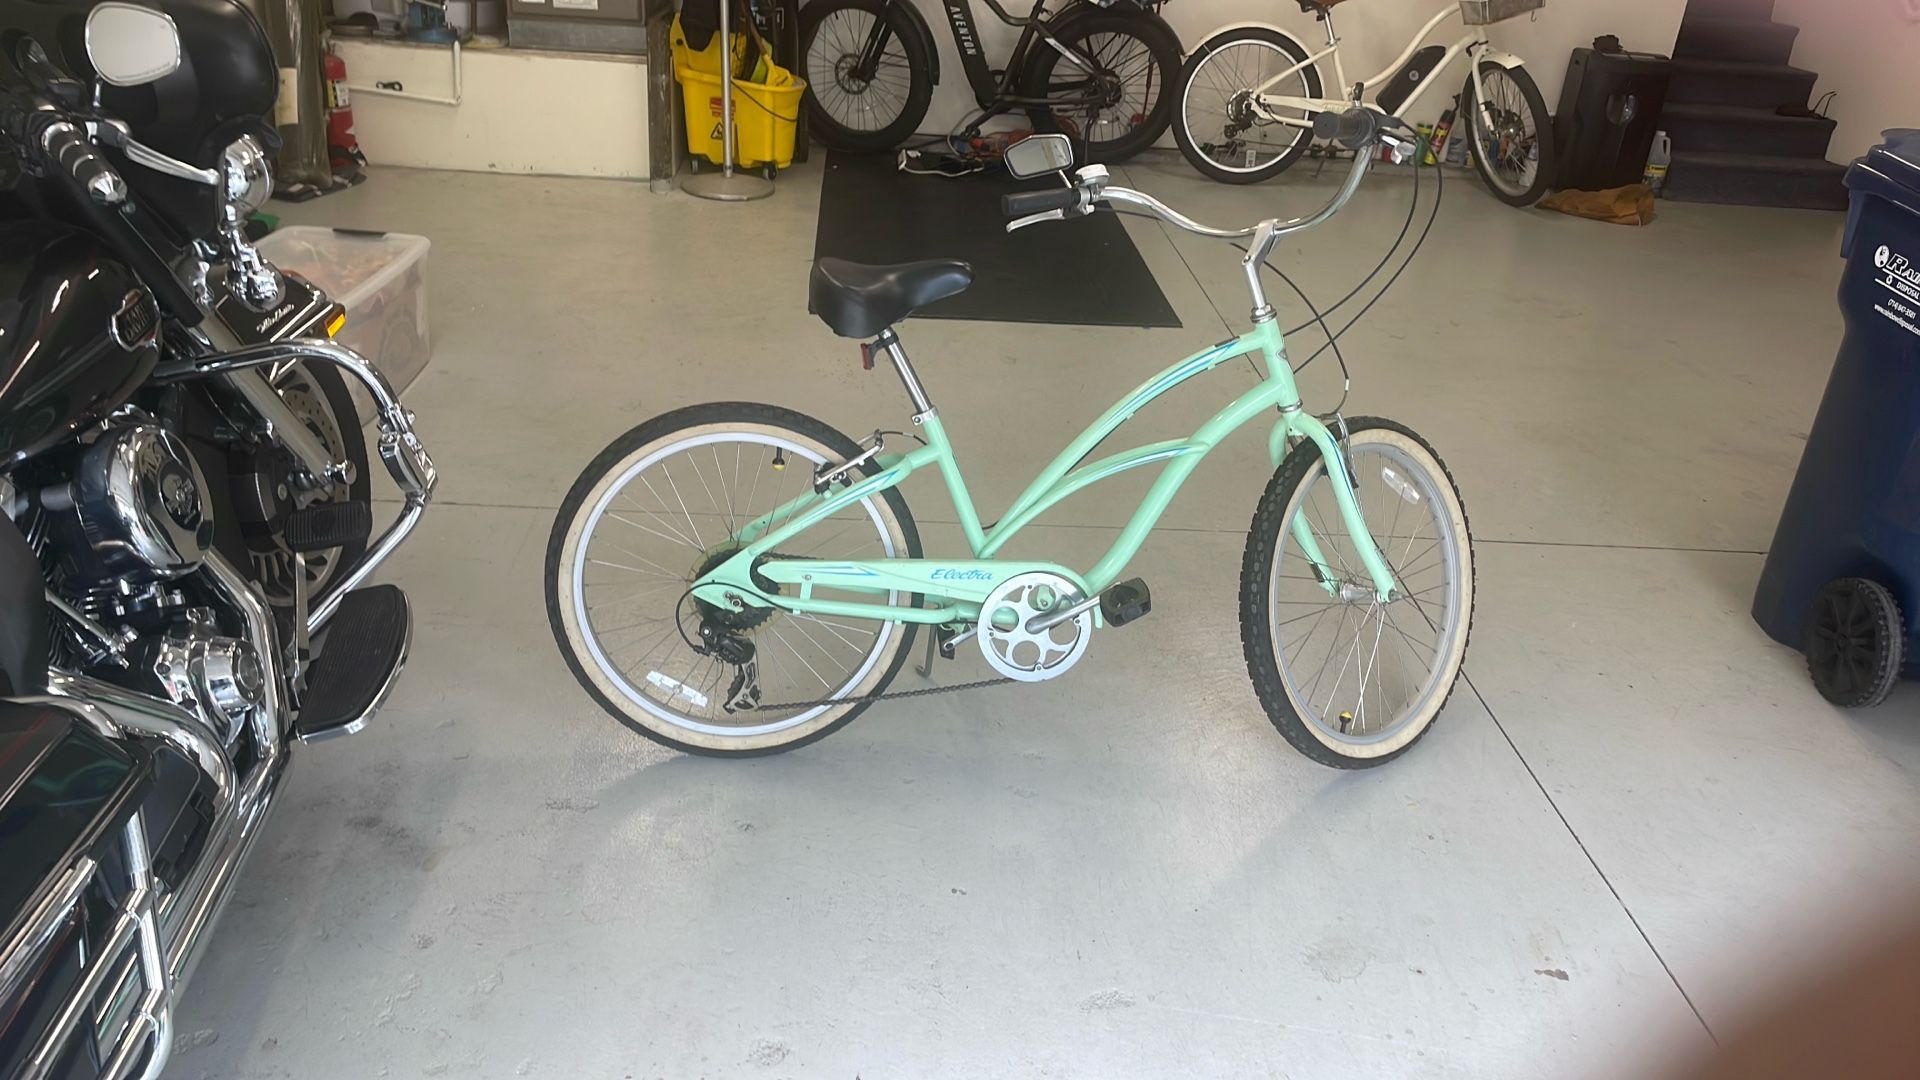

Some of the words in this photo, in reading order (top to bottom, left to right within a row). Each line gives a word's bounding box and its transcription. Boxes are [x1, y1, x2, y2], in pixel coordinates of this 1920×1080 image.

[950, 6, 977, 55] AVENTON
[1885, 253, 1920, 284] RAI
[1896, 281, 1920, 300] DISPOSAL
[931, 568, 993, 580] Electra
